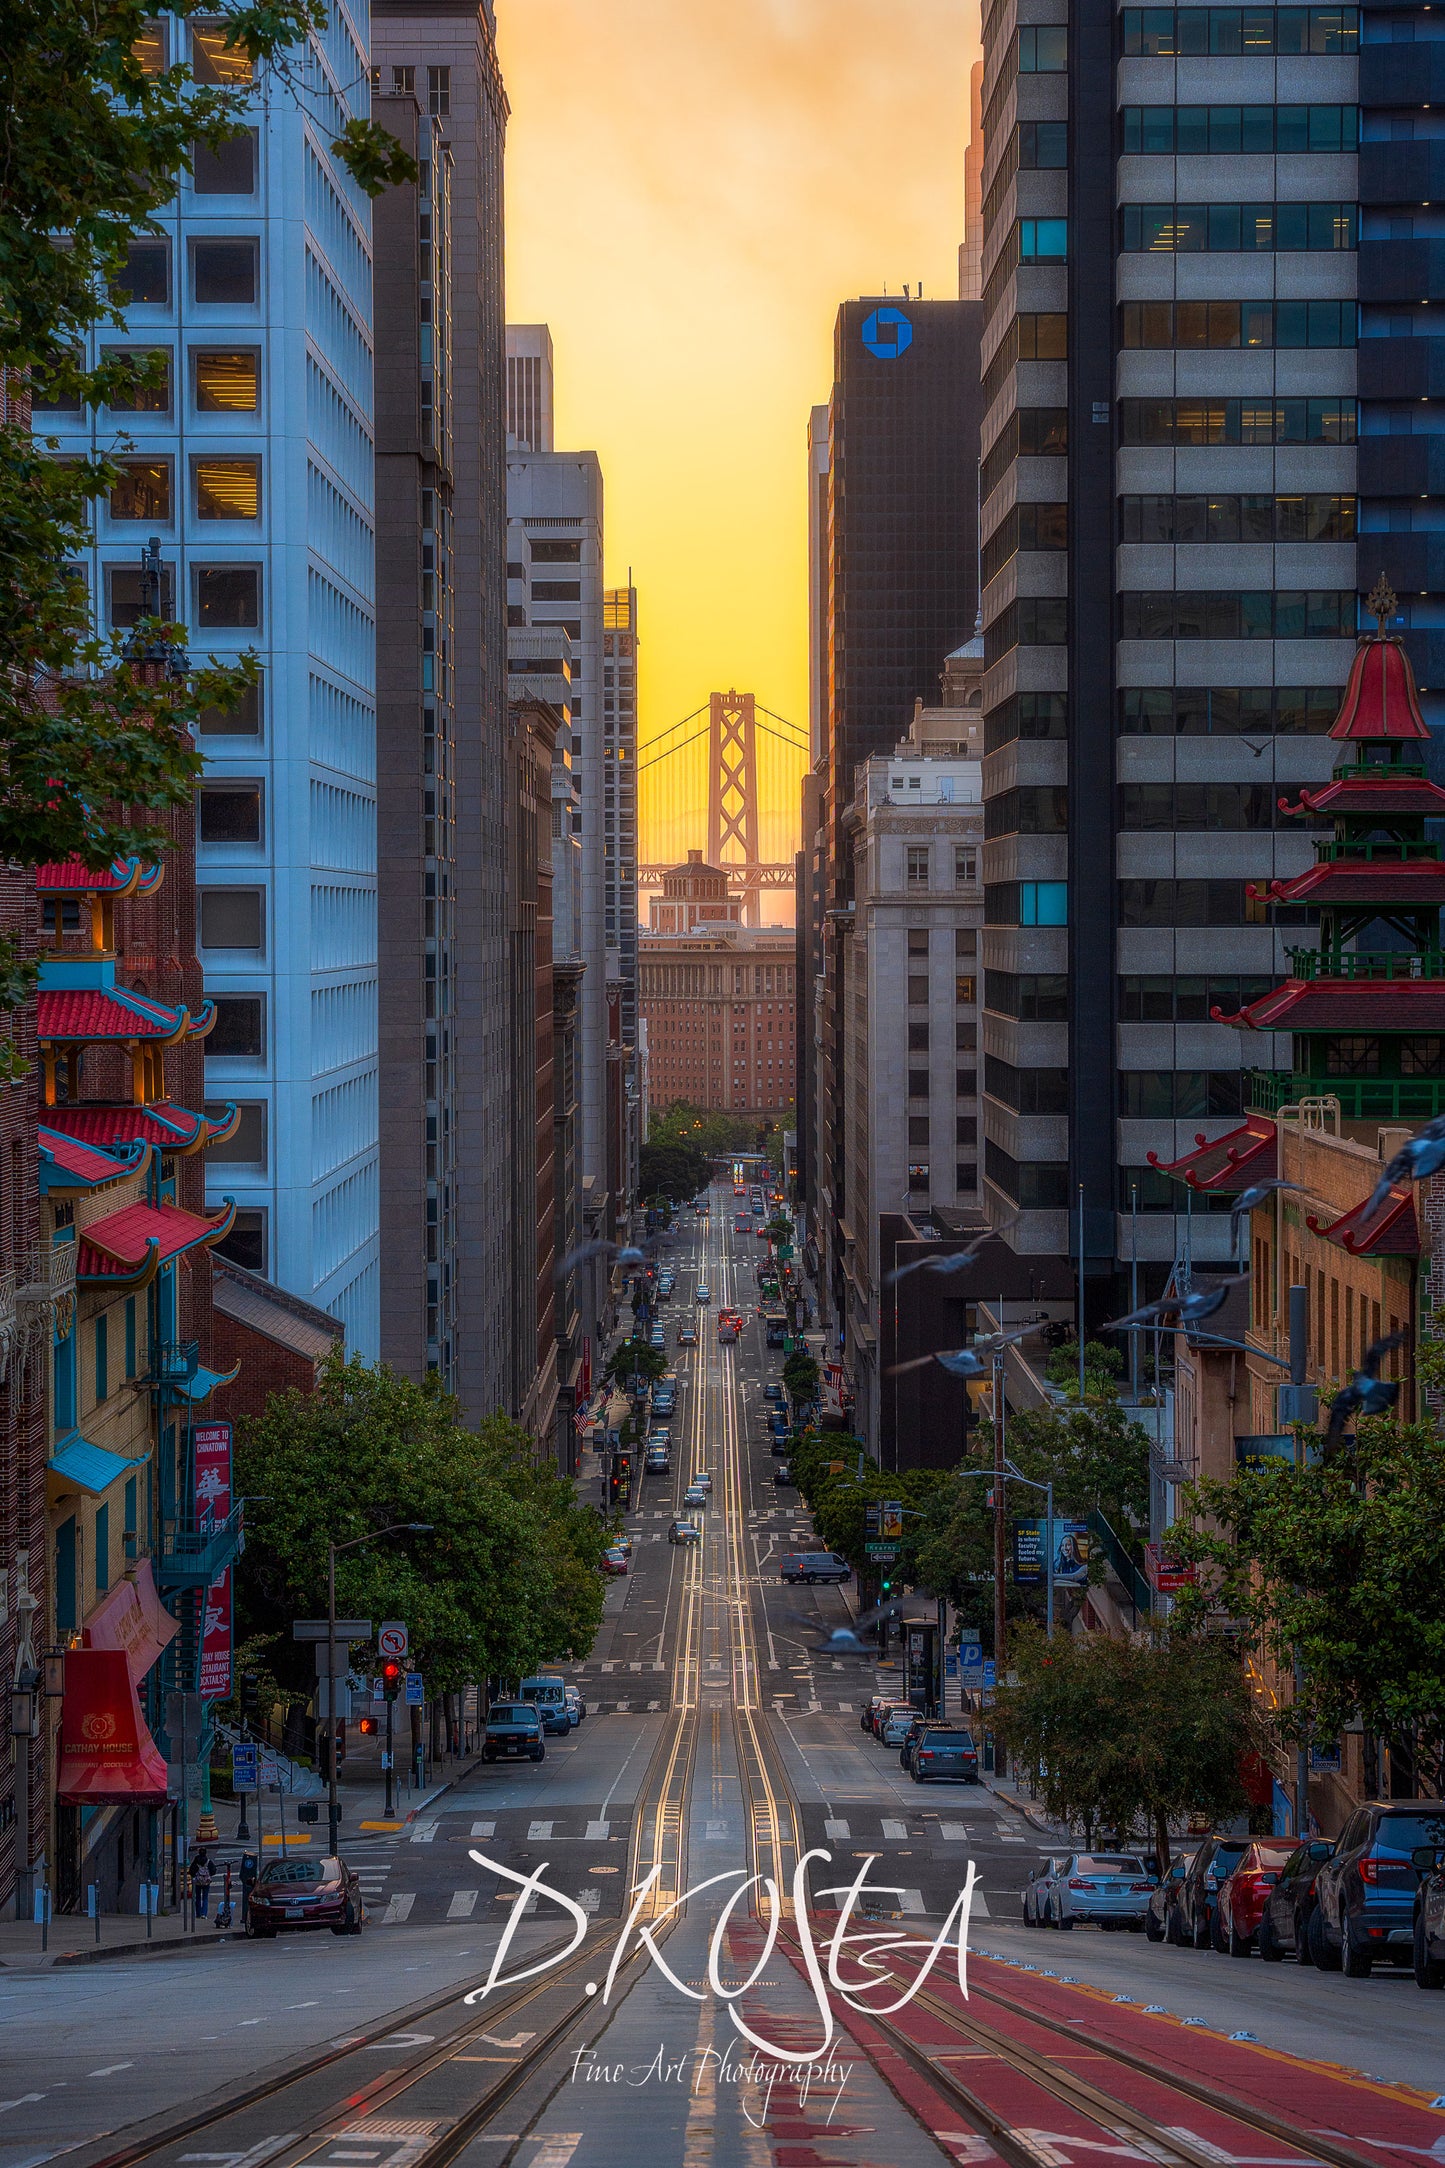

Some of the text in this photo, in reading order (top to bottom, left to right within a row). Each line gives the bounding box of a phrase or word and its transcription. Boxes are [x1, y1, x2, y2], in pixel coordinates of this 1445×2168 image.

[196, 1430, 229, 1442] WELCOME TO
[197, 1442, 227, 1453] CHINATOWN
[1245, 1455, 1257, 1463] SF
[214, 1651, 230, 1661] HOUSE
[65, 1743, 133, 1754] CATHAY HOUSE
